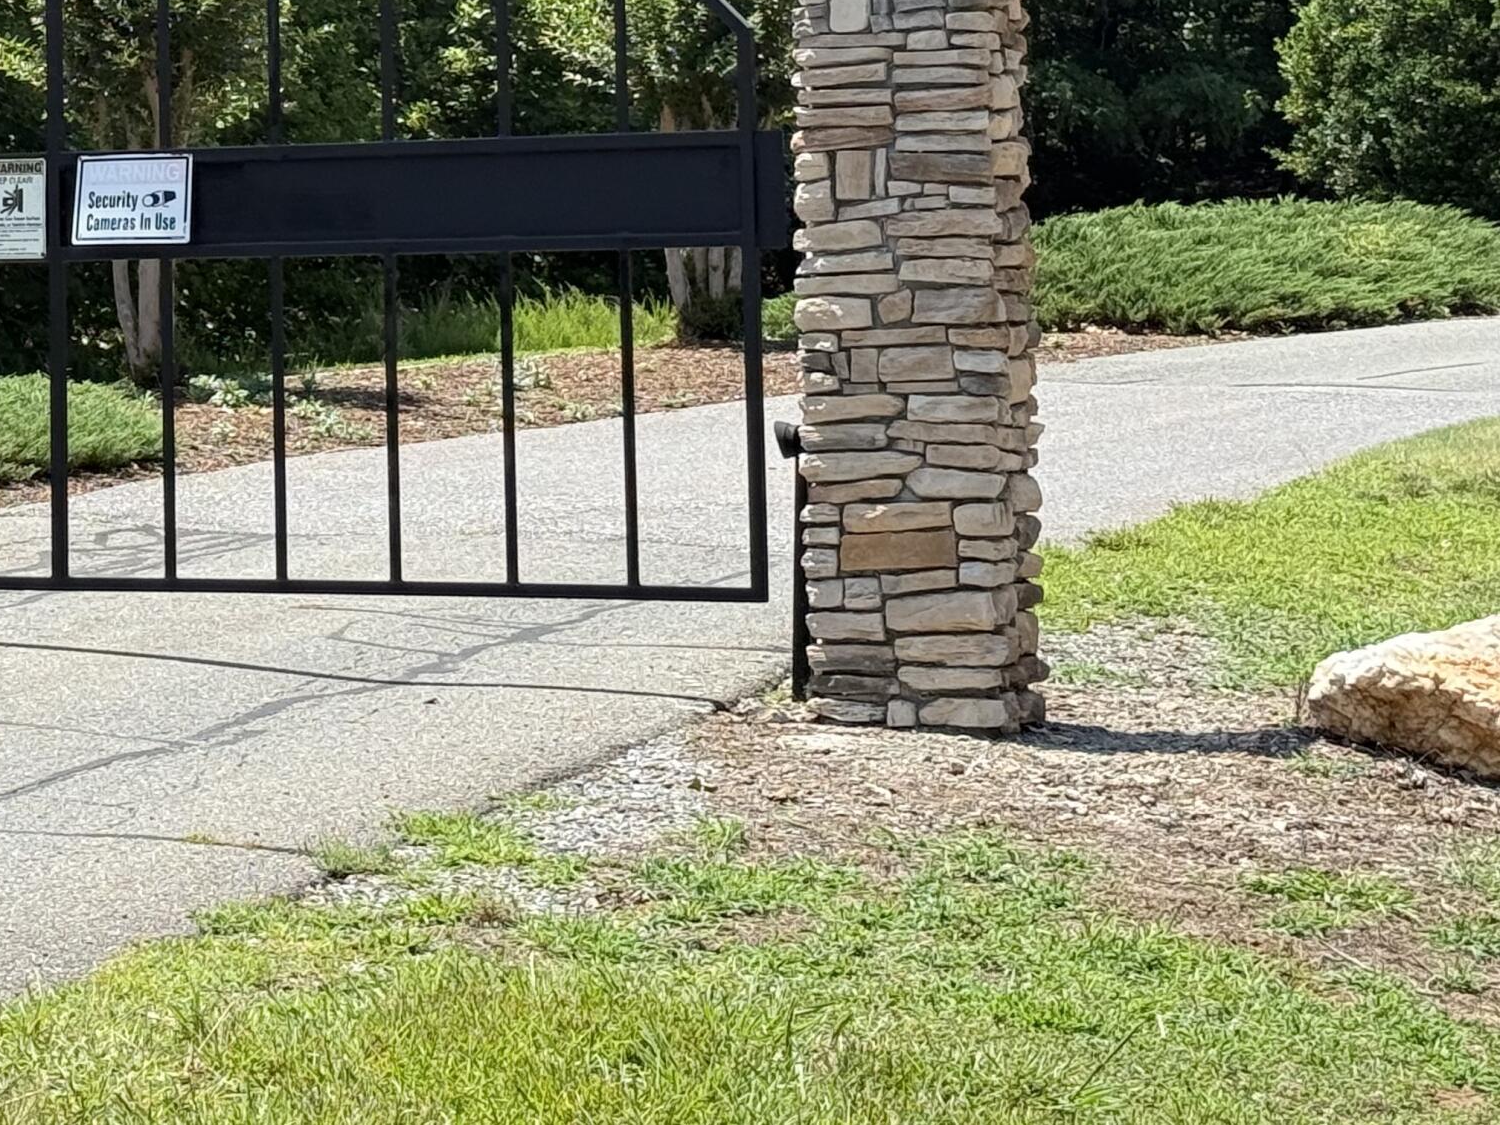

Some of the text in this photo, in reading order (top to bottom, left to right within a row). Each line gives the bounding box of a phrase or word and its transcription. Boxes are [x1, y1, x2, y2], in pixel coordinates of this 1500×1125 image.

[89, 163, 180, 182] WARNING
[88, 190, 138, 212] Security
[86, 212, 176, 231] Cameras In Use
